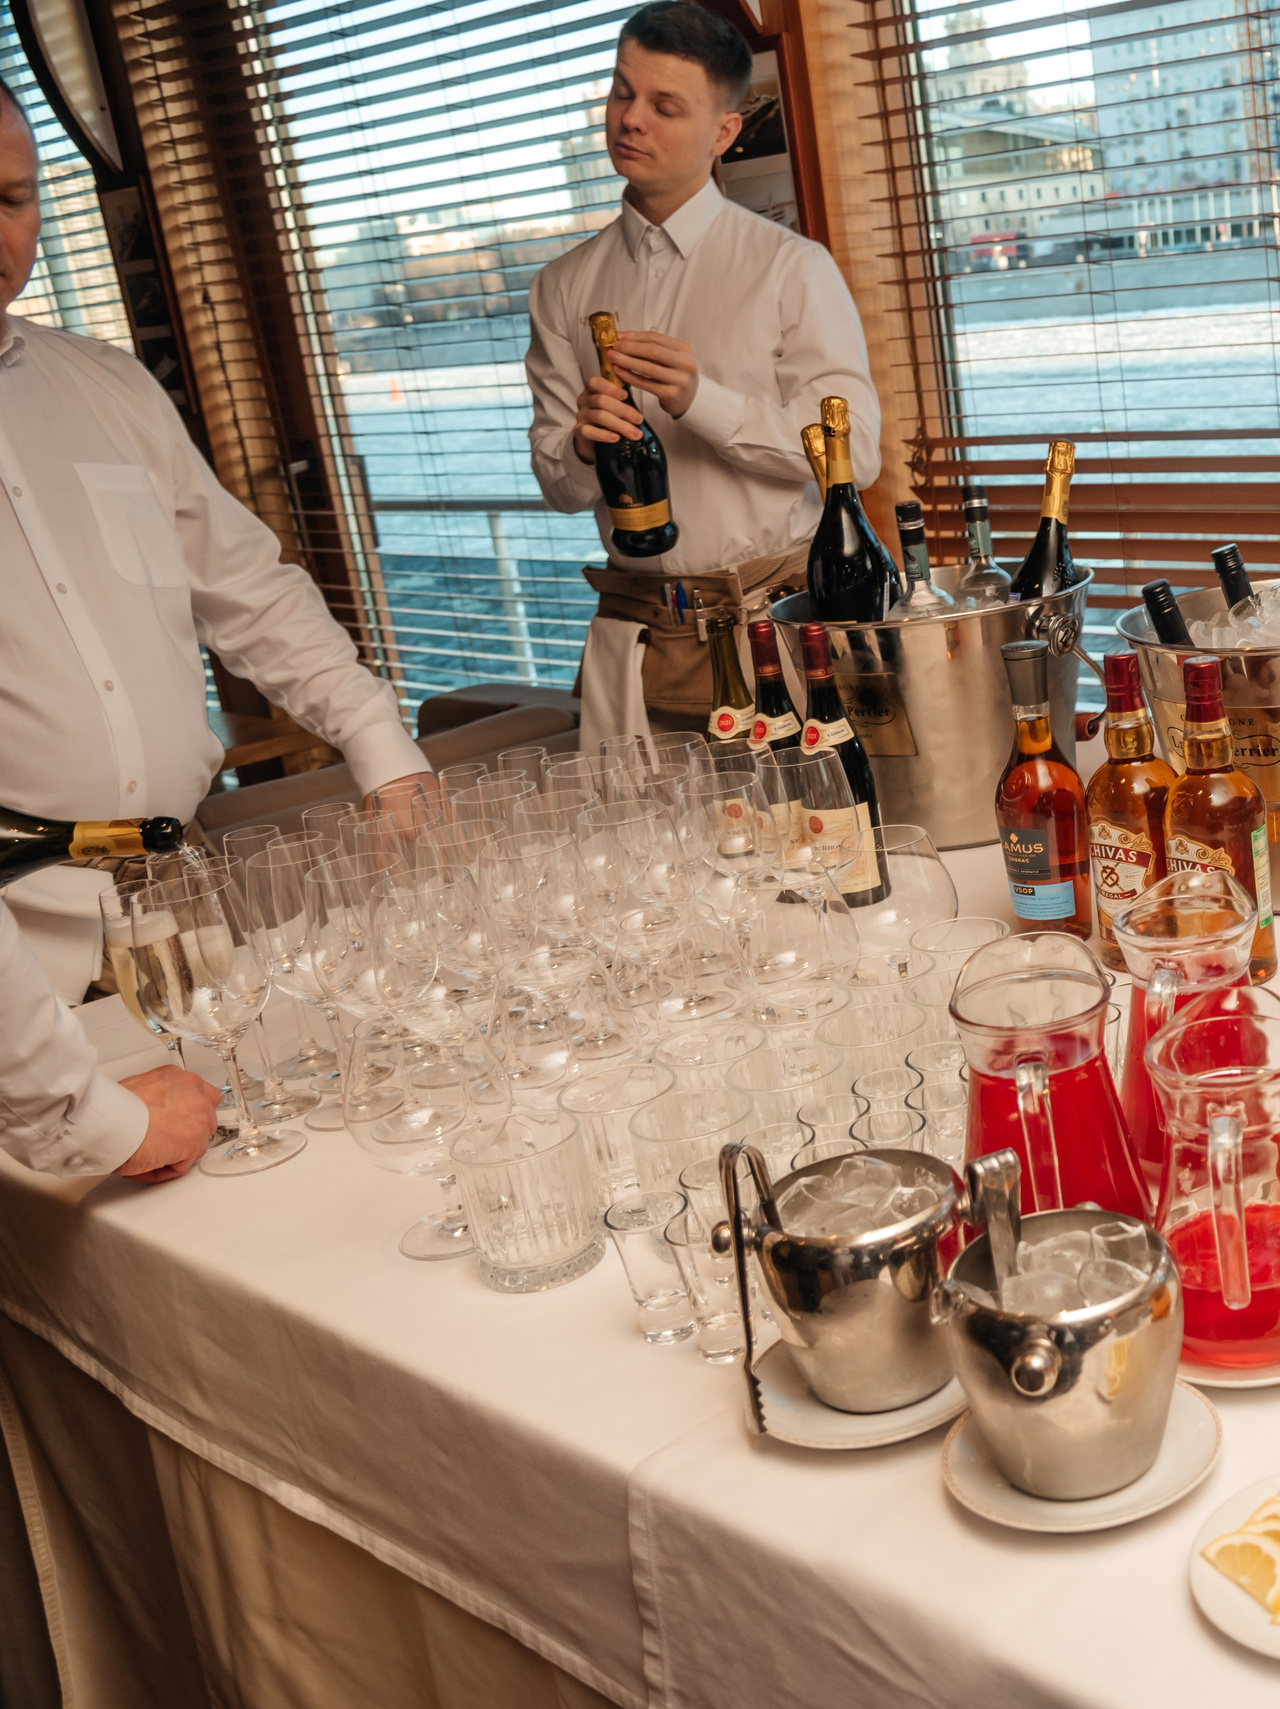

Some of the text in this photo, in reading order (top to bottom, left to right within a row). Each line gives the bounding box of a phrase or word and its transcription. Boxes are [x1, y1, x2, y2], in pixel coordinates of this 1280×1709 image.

[1003, 841, 1044, 854] AMUS
[1090, 844, 1137, 863] CHIVAS
[1166, 857, 1216, 873] CHIVAS
[1014, 886, 1033, 894] VSOP
